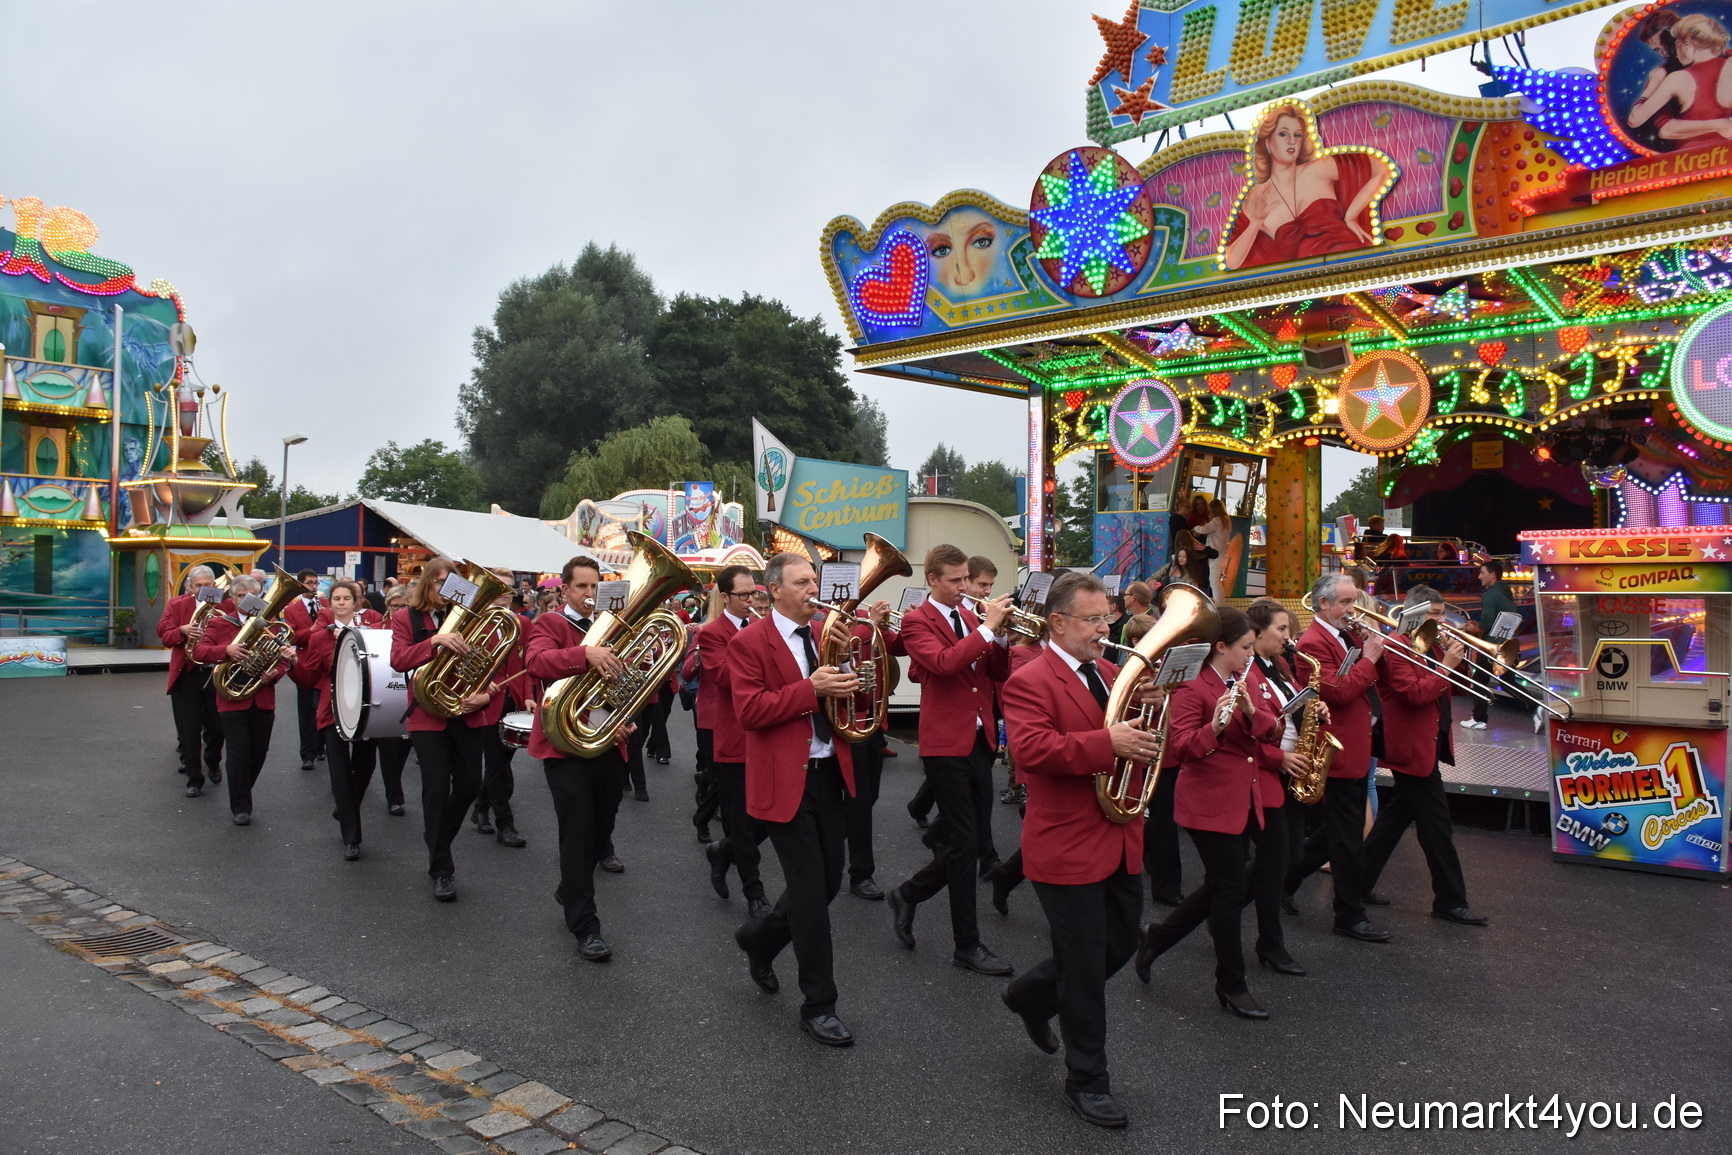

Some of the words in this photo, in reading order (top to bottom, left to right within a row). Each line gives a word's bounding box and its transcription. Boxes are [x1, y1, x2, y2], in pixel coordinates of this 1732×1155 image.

[1589, 159, 1668, 190] Herbert
[1673, 146, 1729, 174] Kreft
[791, 474, 900, 507] Schieß-
[799, 502, 899, 531] Centrum
[1569, 538, 1692, 558] KASSE
[1406, 571, 1446, 581] LOVE
[1595, 579, 1613, 588] Shell
[1618, 566, 1696, 590] COMPAQ
[1597, 597, 1667, 614] KASSE
[1596, 681, 1628, 691] BMW
[1555, 728, 1602, 751] Ferrari
[1569, 751, 1635, 774] Webers
[1559, 768, 1670, 807] FORMEL
[1664, 745, 1709, 810] 1
[1555, 814, 1611, 851] BMW
[1644, 800, 1710, 847] Circus
[1685, 833, 1723, 852] FIAT
